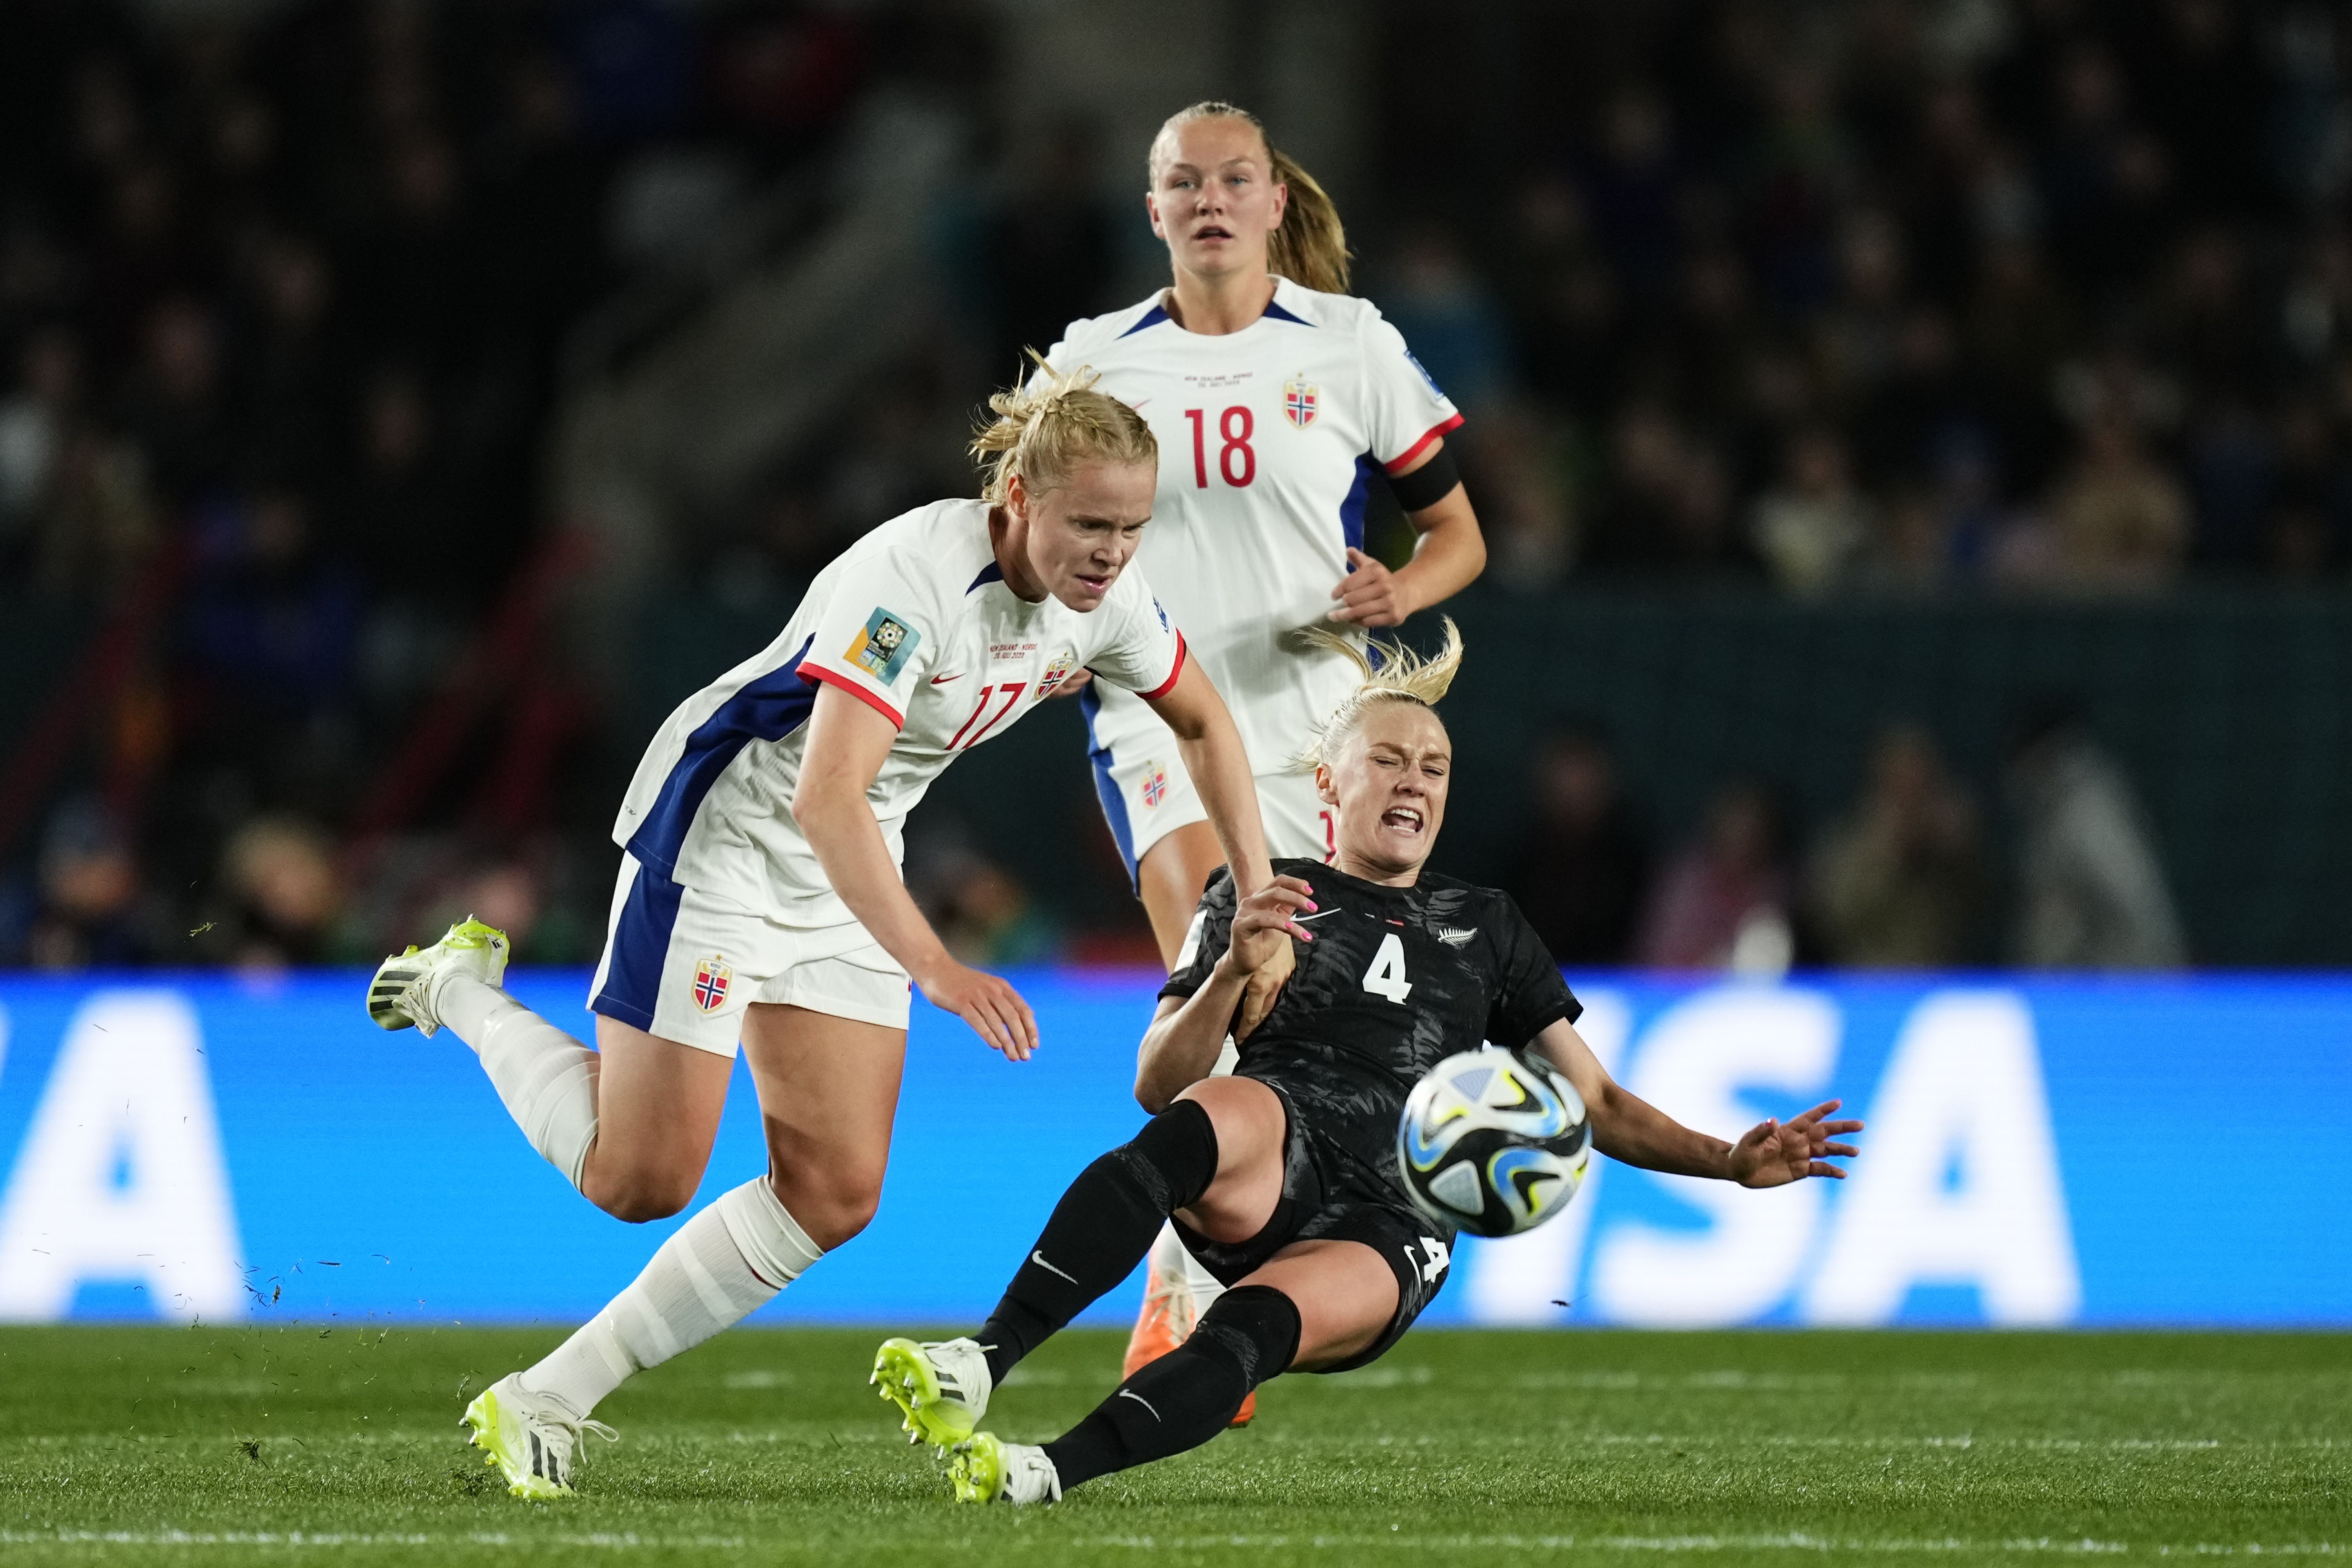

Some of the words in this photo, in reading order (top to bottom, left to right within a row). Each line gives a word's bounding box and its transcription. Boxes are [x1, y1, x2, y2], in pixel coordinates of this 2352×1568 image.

[1185, 405, 1255, 488] 18
[944, 682, 1027, 750] 17
[1362, 933, 1412, 1005] 4
[0, 986, 251, 1324] A
[1464, 984, 2083, 1329] ISA
[1419, 1236, 1450, 1283] 4
